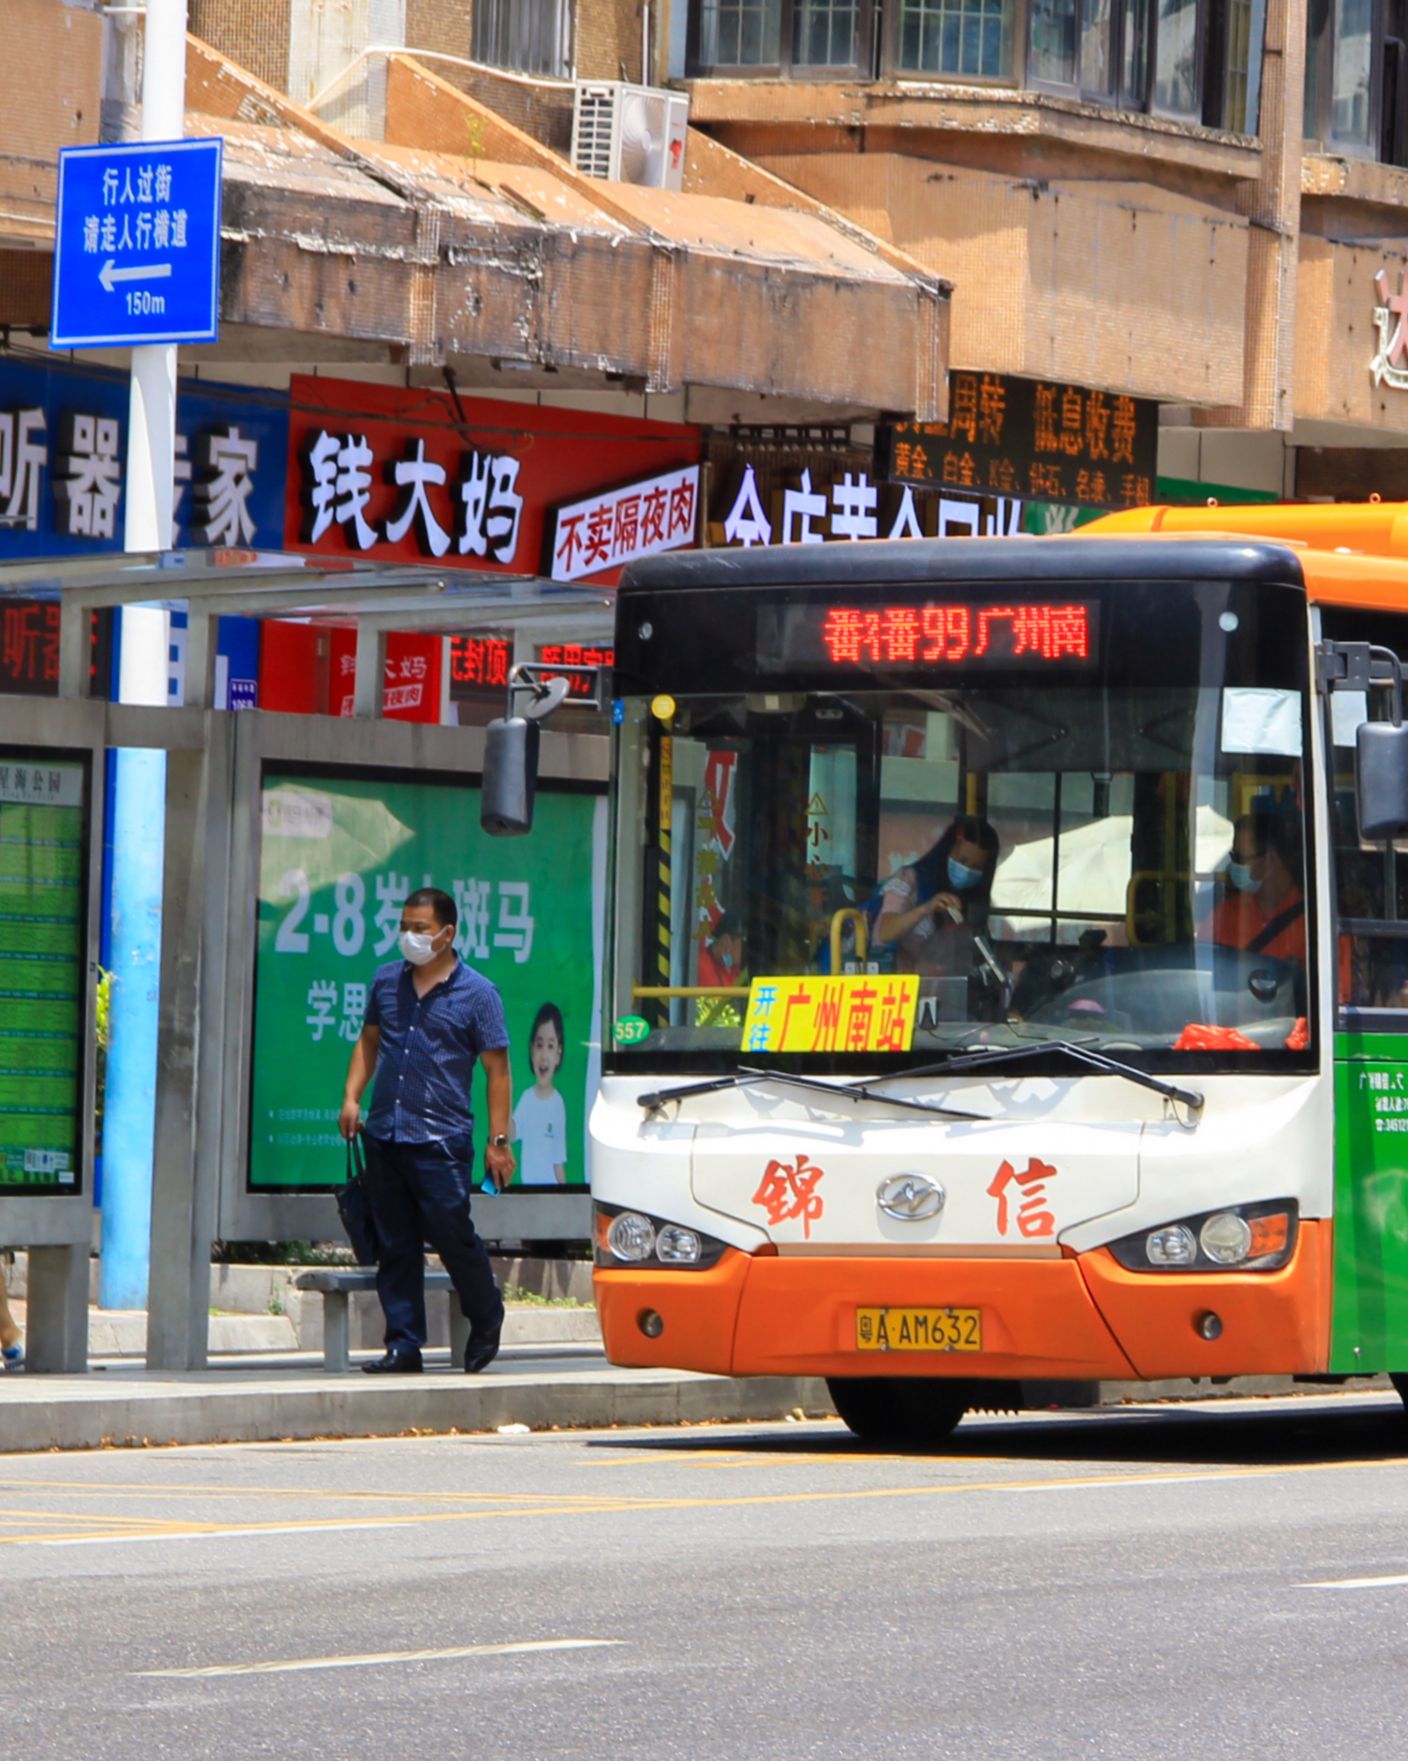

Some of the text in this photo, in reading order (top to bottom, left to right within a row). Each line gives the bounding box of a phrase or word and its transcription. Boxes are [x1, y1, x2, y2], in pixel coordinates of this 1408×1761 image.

[103, 164, 172, 206] 行人过街
[83, 209, 188, 253] 请走人行横道
[126, 291, 165, 315] 150m
[0, 407, 257, 548] 听器家
[309, 429, 524, 564] 钱大妈
[555, 476, 695, 572] 不卖隔夜肉
[275, 868, 535, 964] 2-8岁斑马
[615, 1021, 646, 1040] 557
[748, 985, 777, 1053] 开往
[778, 980, 911, 1053] 广州南站
